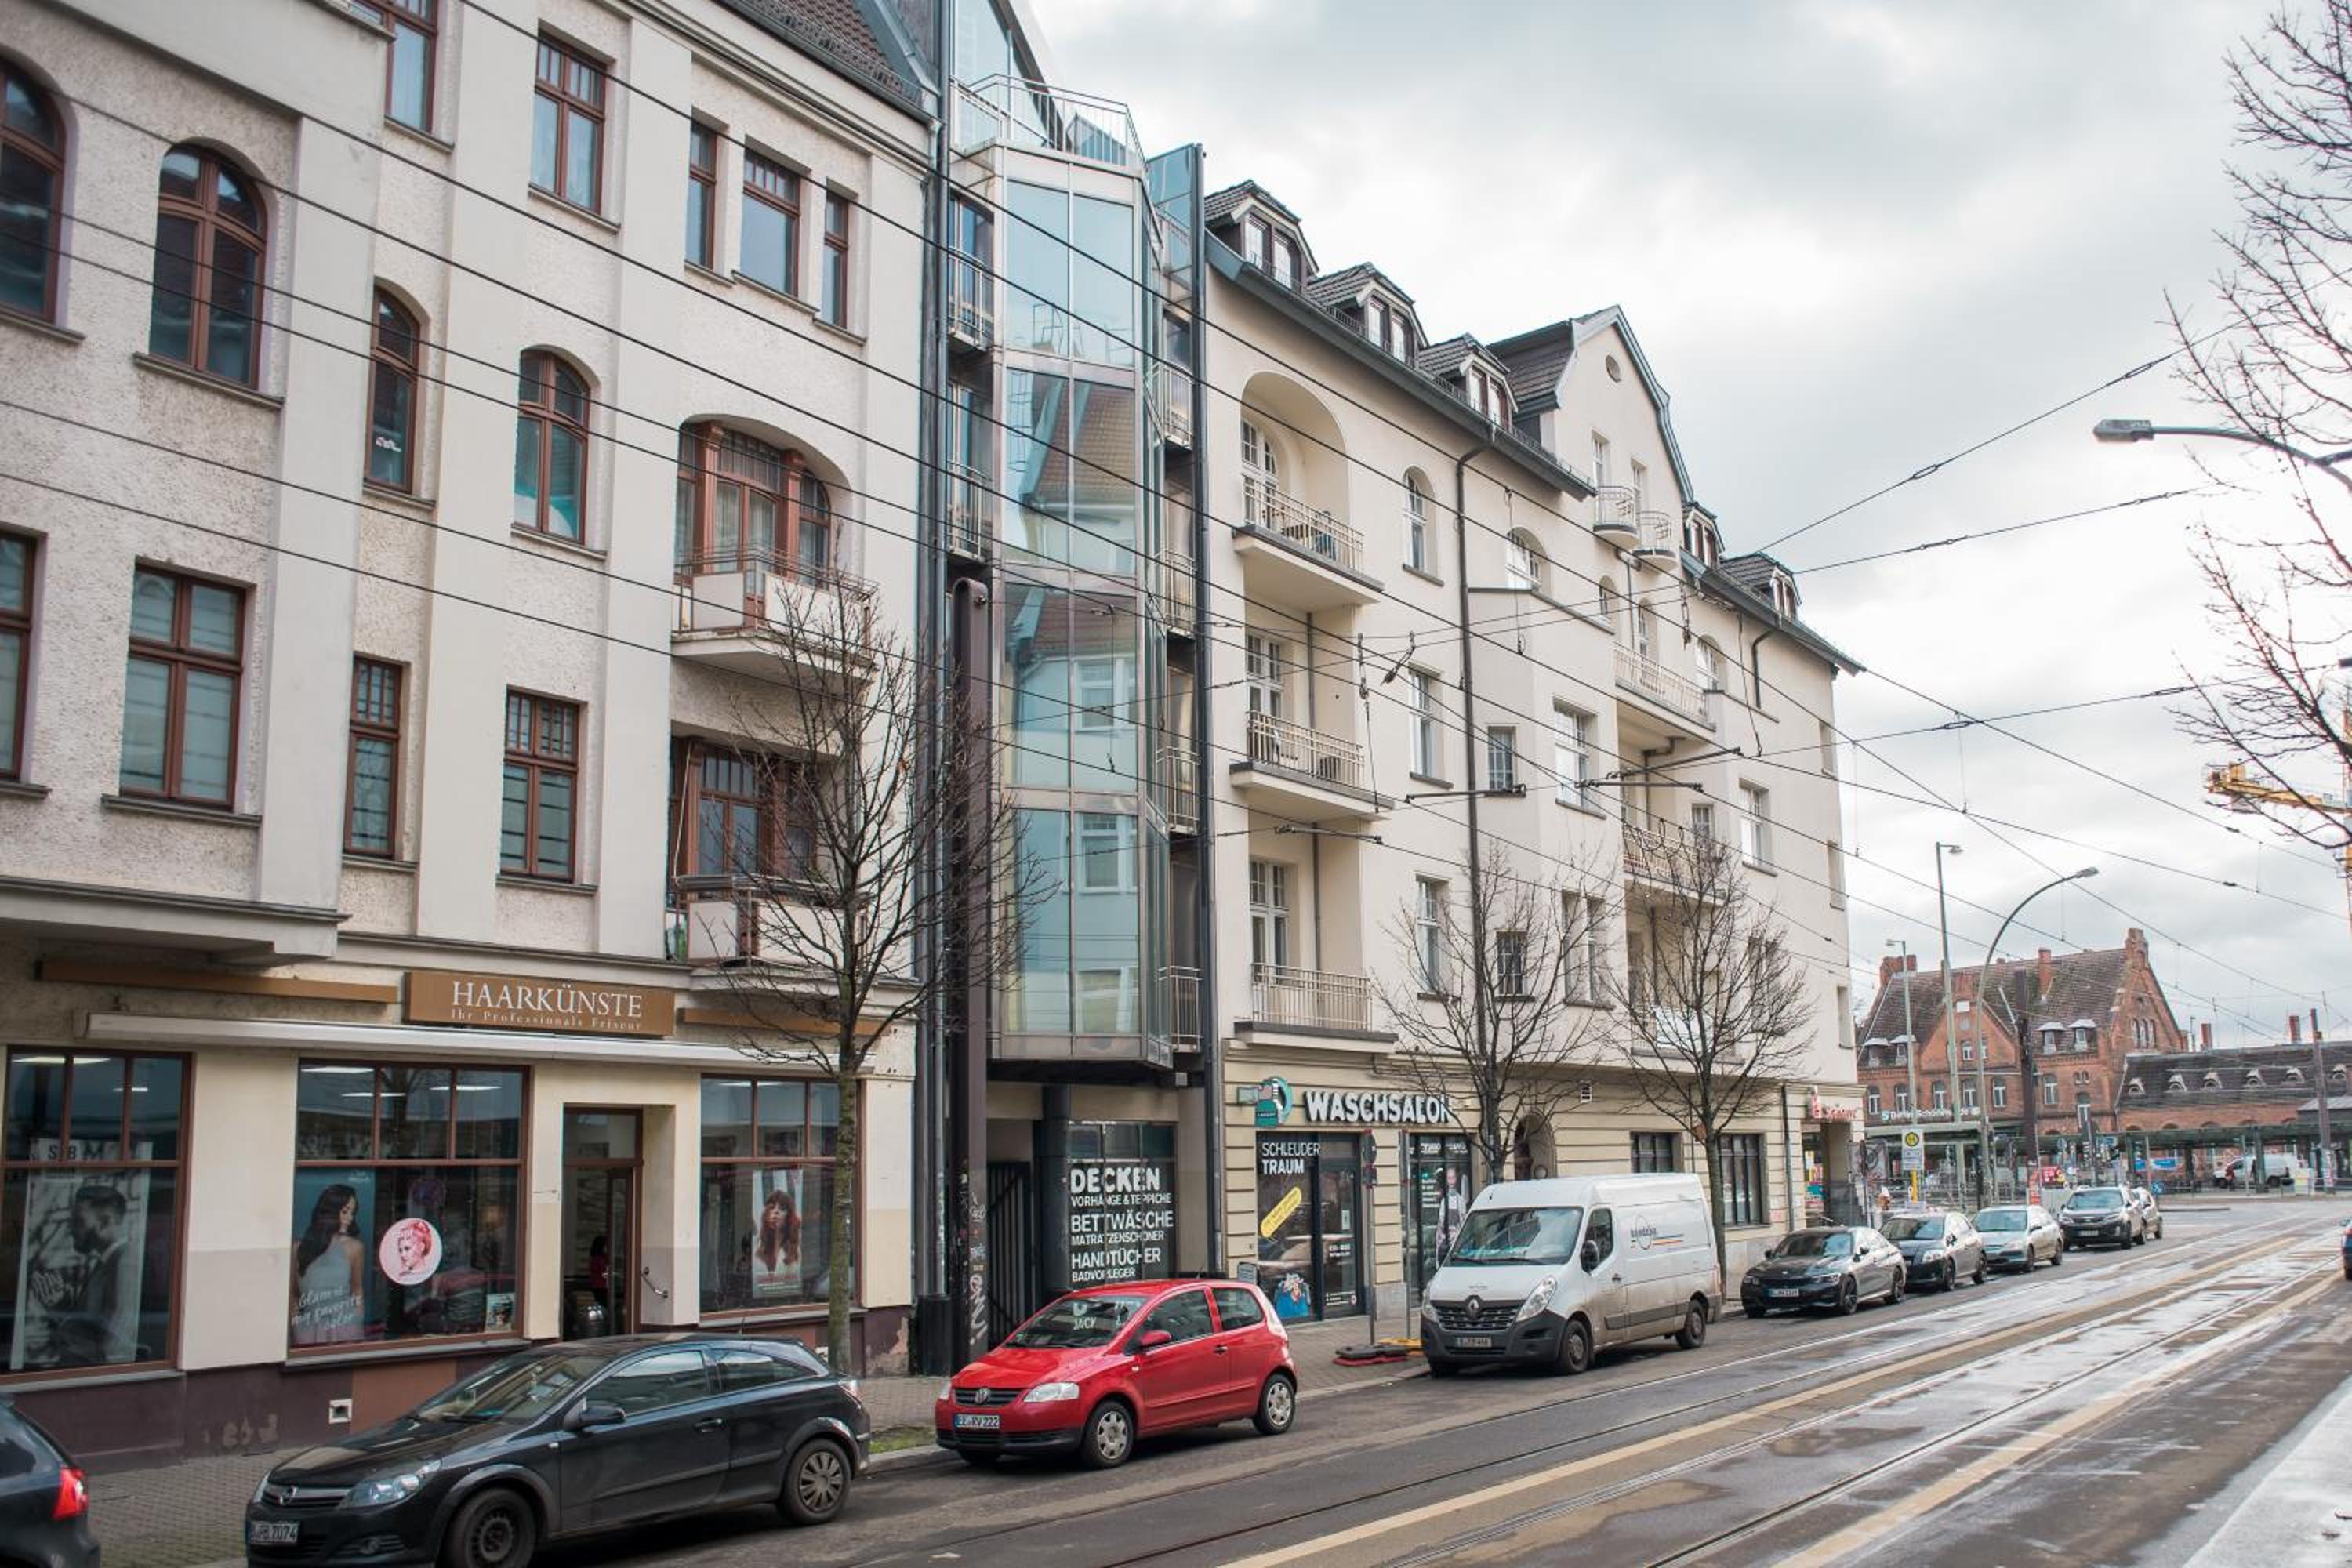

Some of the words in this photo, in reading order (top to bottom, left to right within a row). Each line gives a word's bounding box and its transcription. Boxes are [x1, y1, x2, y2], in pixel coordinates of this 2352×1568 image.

[452, 981, 642, 1018] HAARKÜNSTE
[1305, 1090, 1453, 1124] WASCHSALON
[1261, 1142, 1322, 1158] SCHLEUDER
[1261, 1158, 1305, 1175] TRAUM
[1070, 1167, 1160, 1194] DECKEN
[1071, 1209, 1174, 1232] BETTWÄSCHE
[1072, 1247, 1162, 1269] HANDTÜCHER
[983, 1416, 999, 1428] 222
